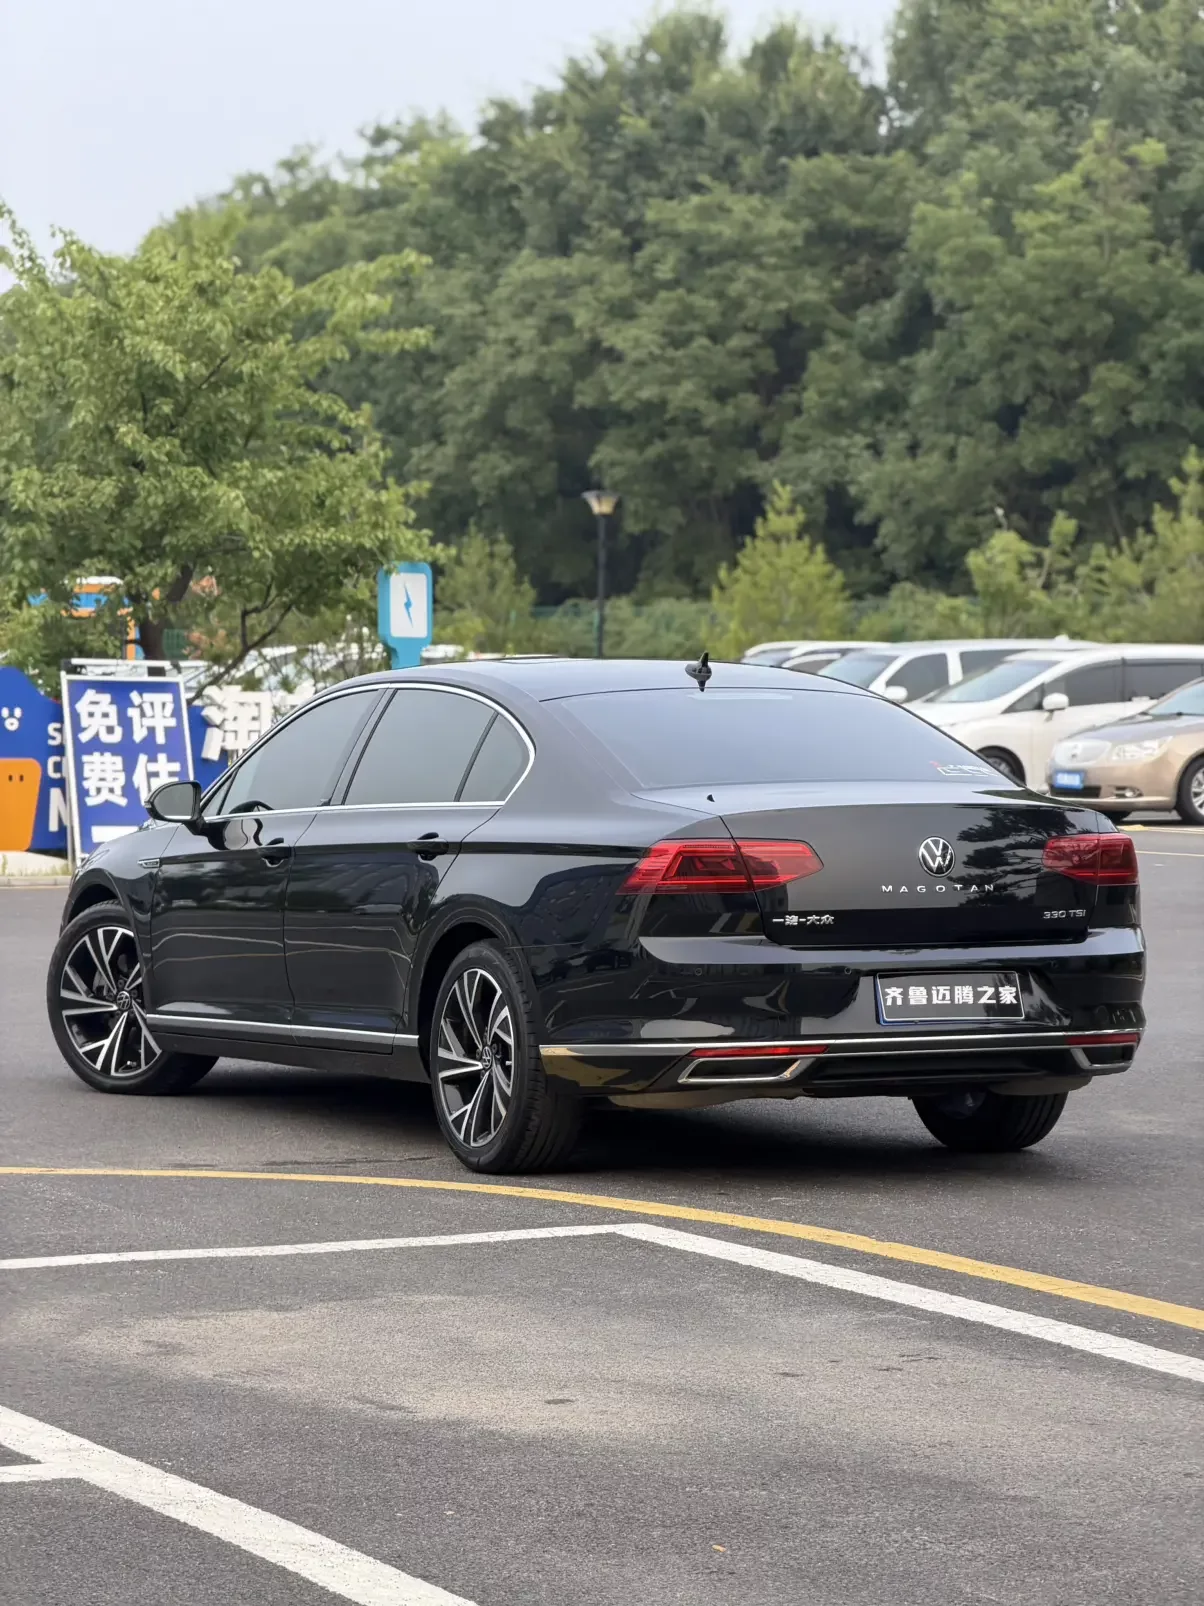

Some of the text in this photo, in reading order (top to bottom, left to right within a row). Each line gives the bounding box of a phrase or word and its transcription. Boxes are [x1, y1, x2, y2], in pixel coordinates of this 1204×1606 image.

[881, 884, 994, 893] MAGOTAN
[1043, 909, 1087, 919] 330 TSI
[884, 985, 1018, 1006] 齐鲁迈腾之家
